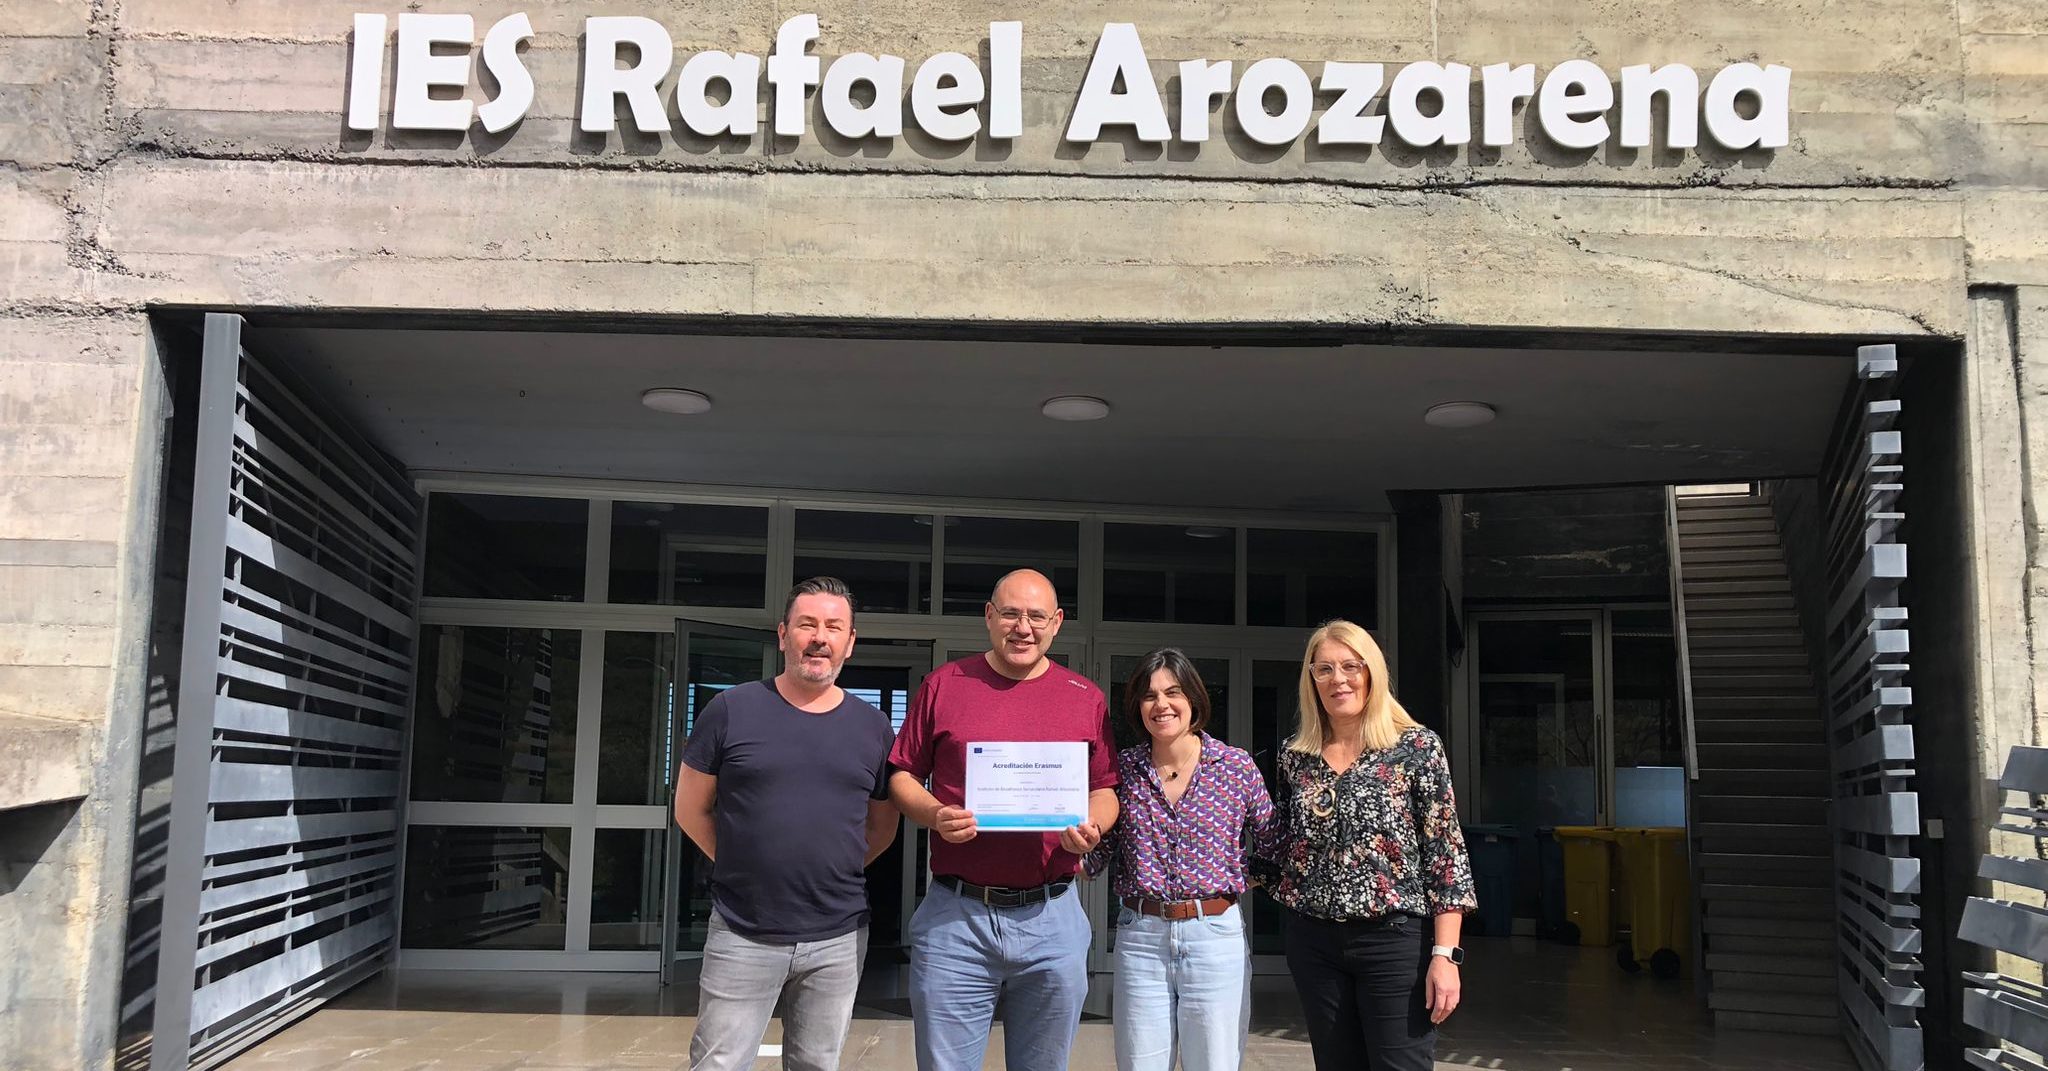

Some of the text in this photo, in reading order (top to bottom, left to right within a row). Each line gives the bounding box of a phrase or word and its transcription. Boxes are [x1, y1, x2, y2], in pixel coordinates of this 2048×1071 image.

[347, 12, 1792, 150] IES Rafael Arozarena
